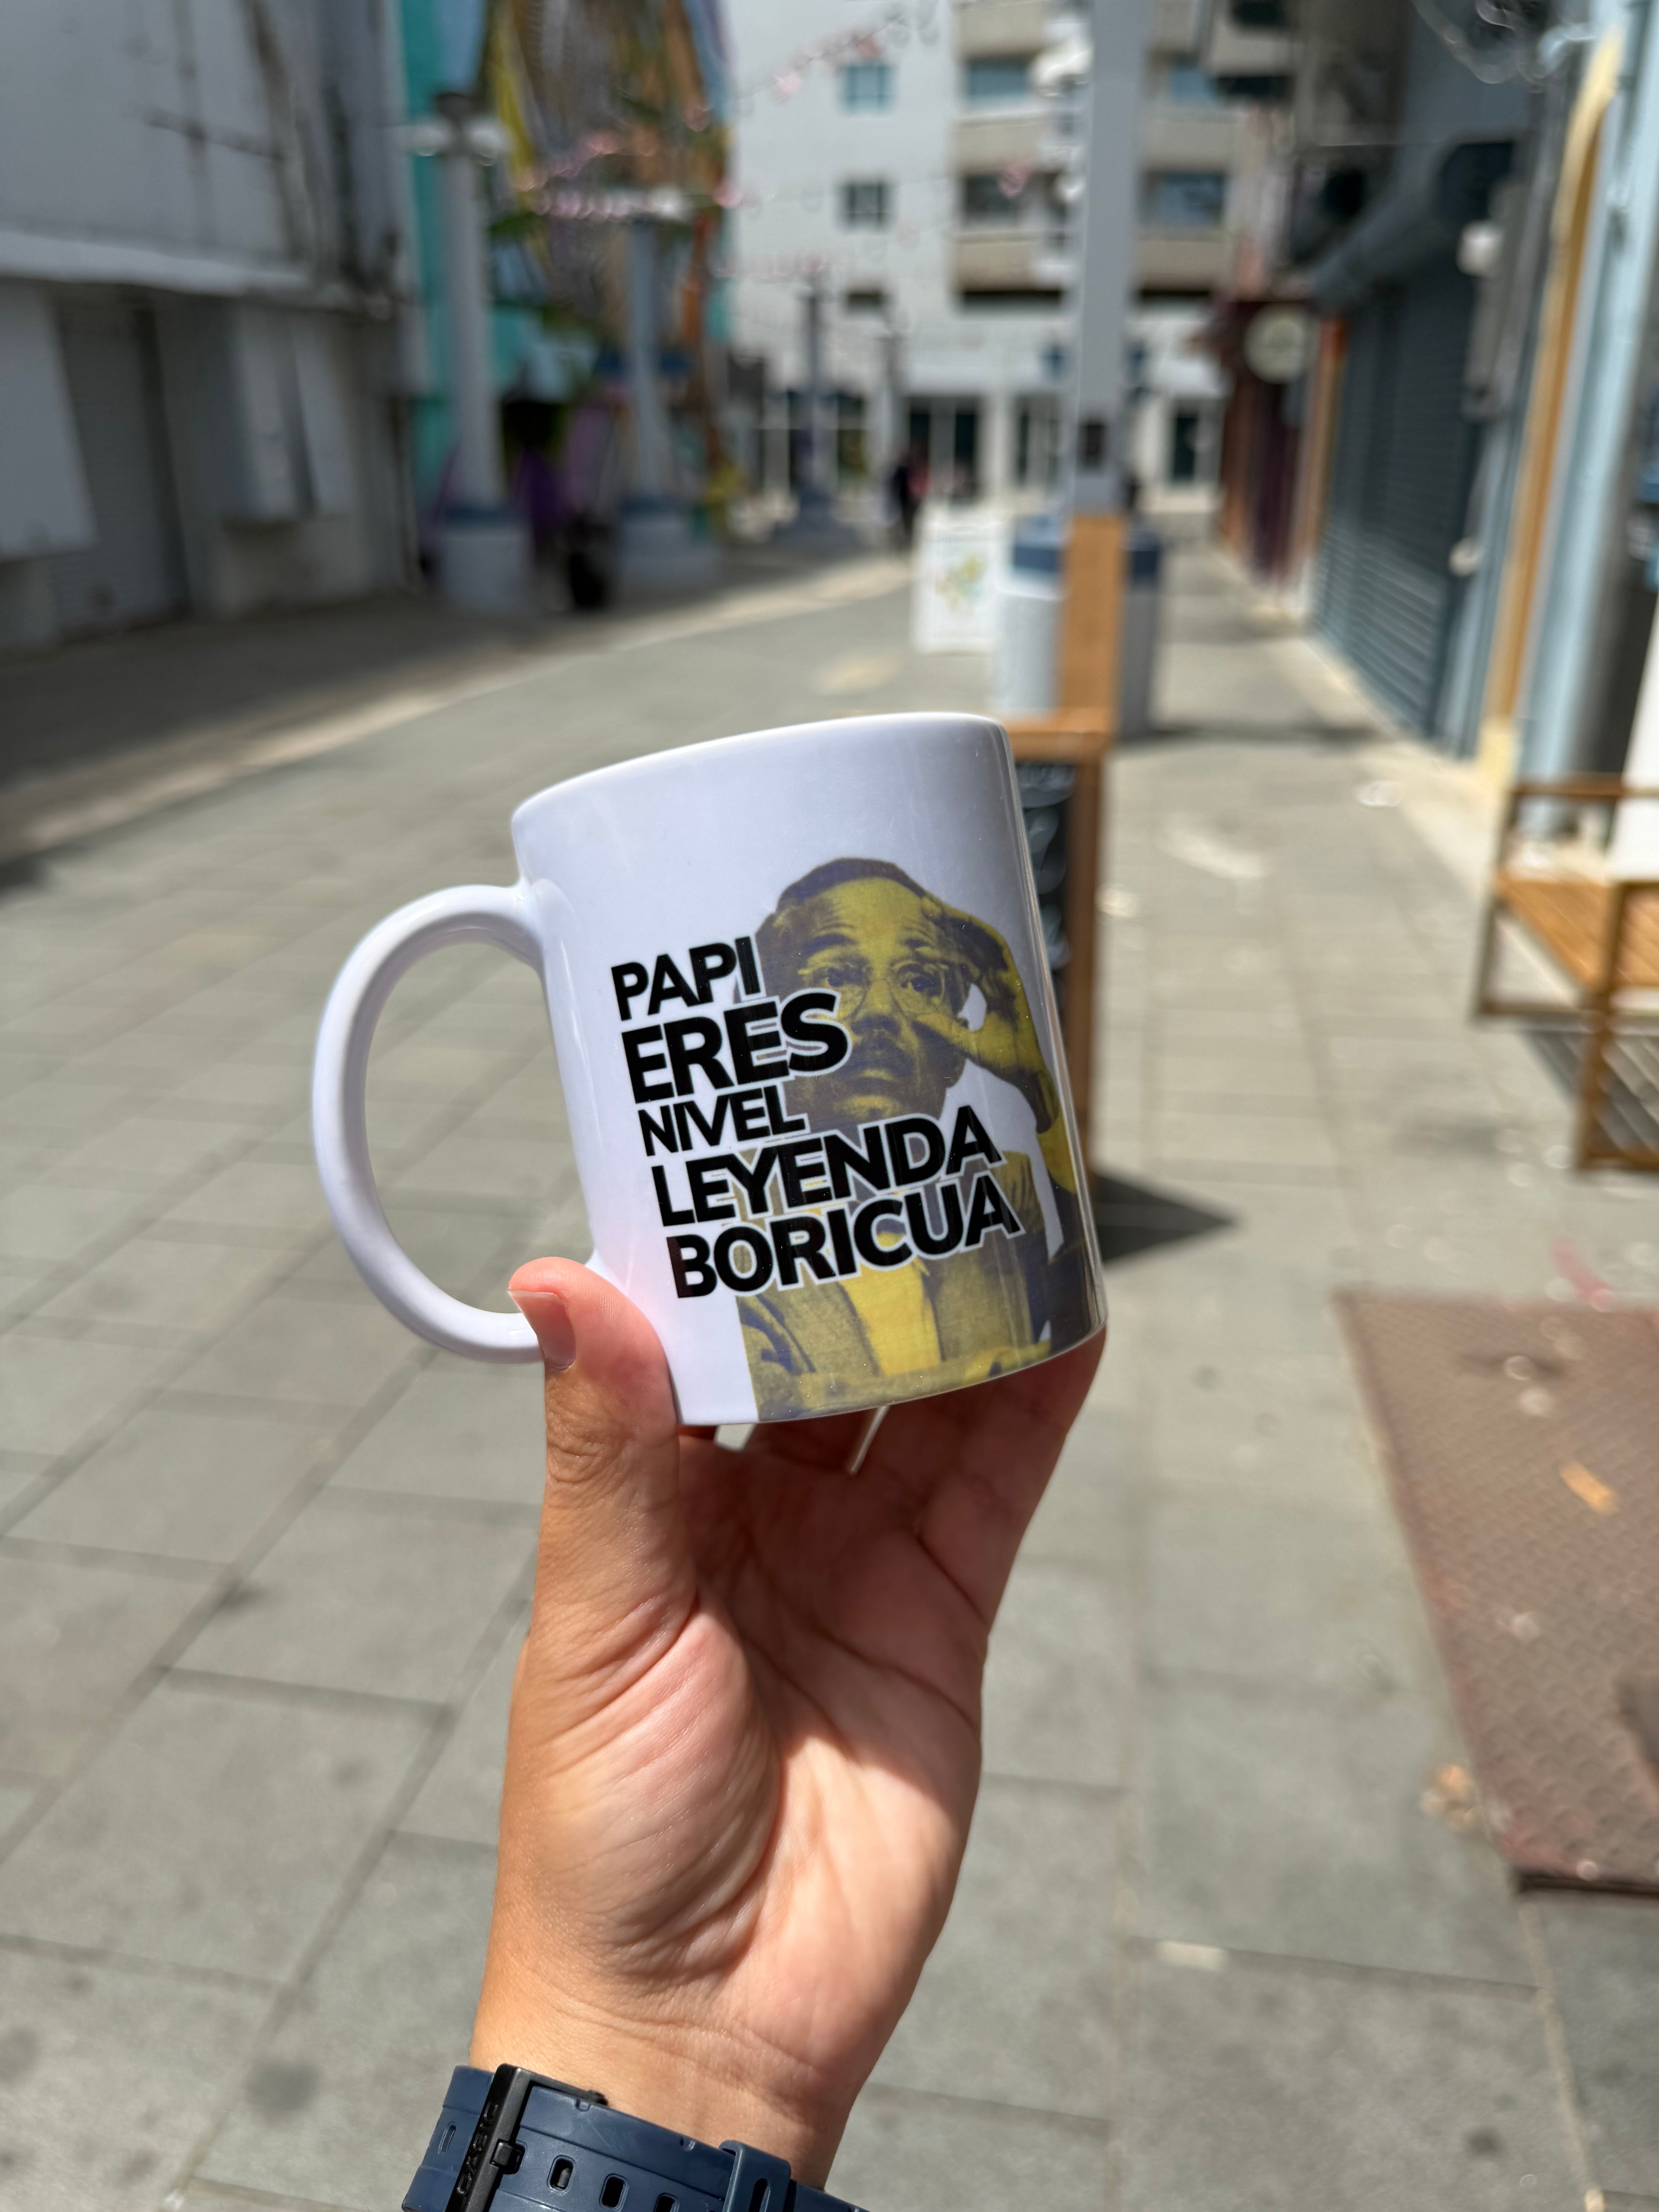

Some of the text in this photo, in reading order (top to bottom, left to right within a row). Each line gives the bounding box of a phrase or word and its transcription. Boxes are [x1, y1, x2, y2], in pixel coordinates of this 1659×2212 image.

[611, 936, 761, 1021] PAPI
[621, 992, 848, 1104] ERES
[637, 1084, 806, 1156] NIVEL
[651, 1105, 1003, 1226] LEYENDA
[666, 1175, 1021, 1298] BORICUA
[456, 2100, 498, 2195] CASIO
